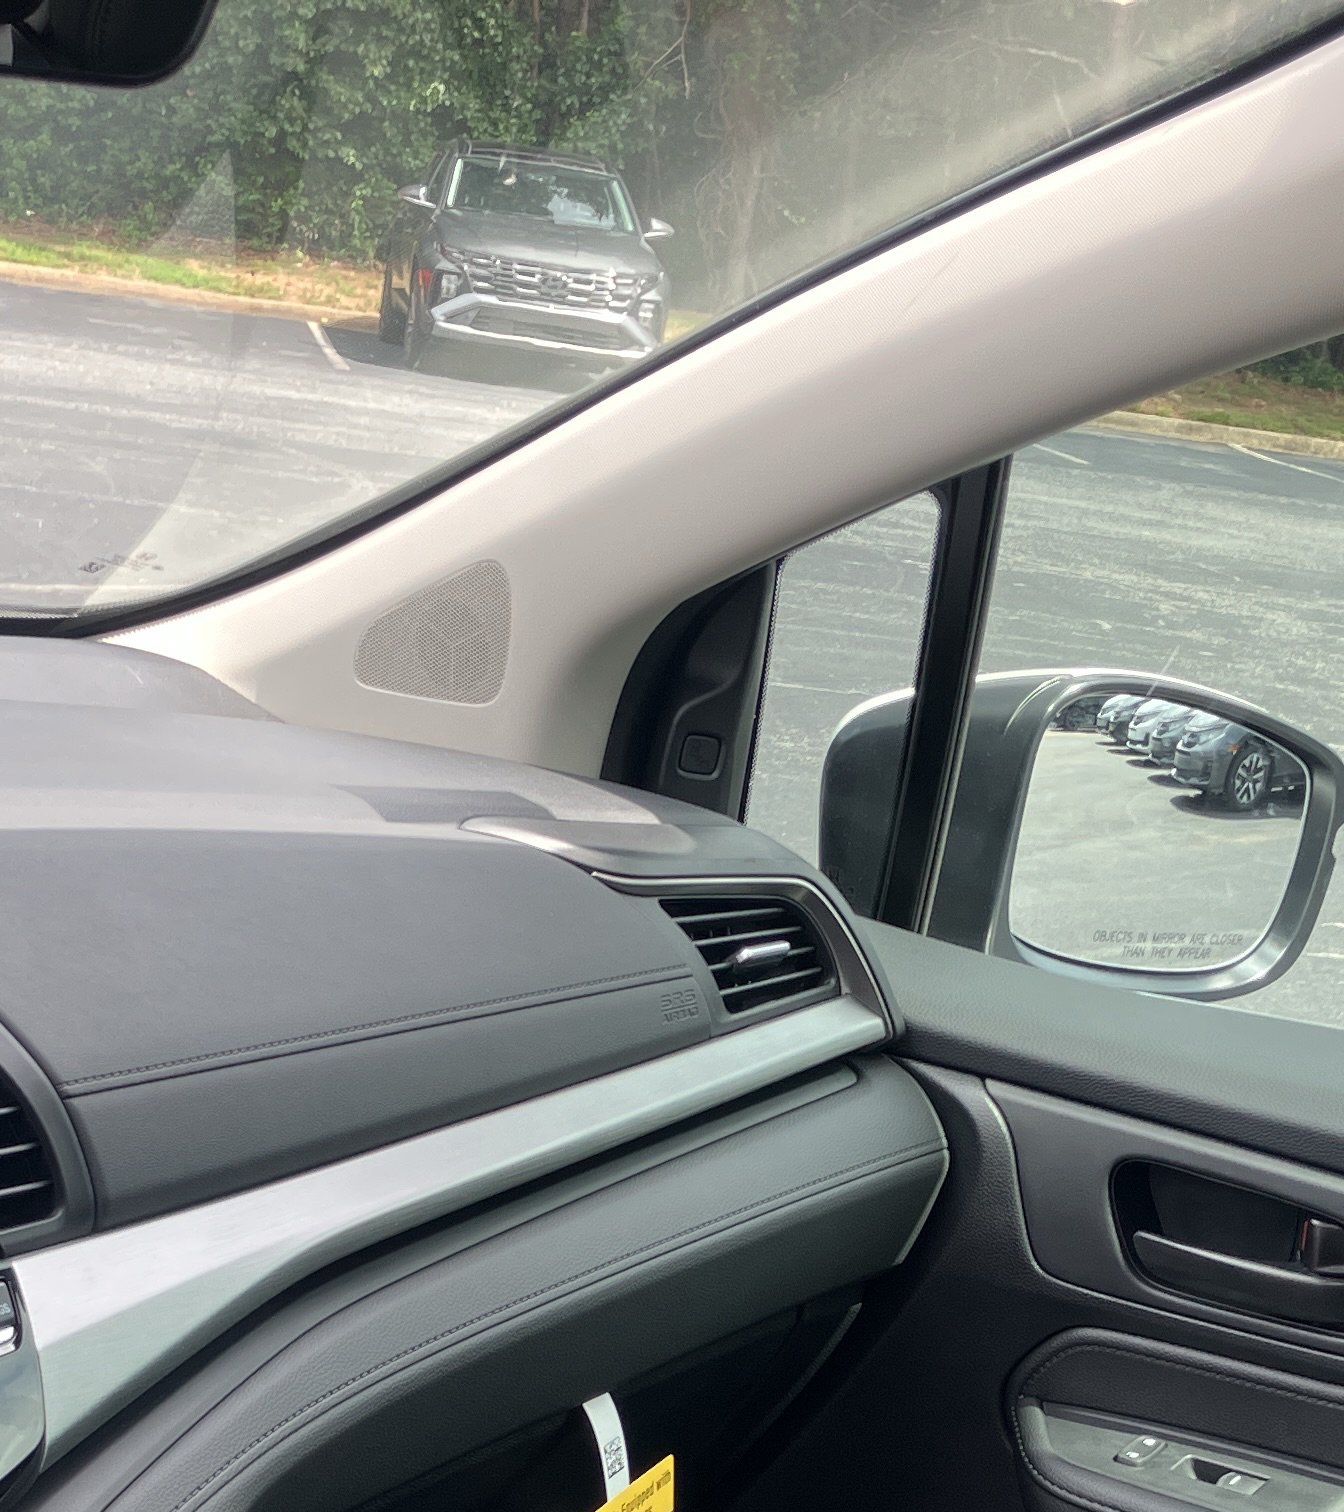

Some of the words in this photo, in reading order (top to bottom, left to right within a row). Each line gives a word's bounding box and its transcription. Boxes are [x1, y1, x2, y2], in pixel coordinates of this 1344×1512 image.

[1092, 930, 1133, 943] OBJECTS
[1137, 931, 1148, 943] IN
[1152, 932, 1186, 944] MIRROR
[1189, 933, 1207, 944] ARE
[1210, 933, 1243, 945] CLOSER
[1121, 946, 1145, 958] THAN
[1150, 946, 1173, 958] THEY
[1177, 947, 1212, 959] APPEAR
[655, 1470, 672, 1491] with
